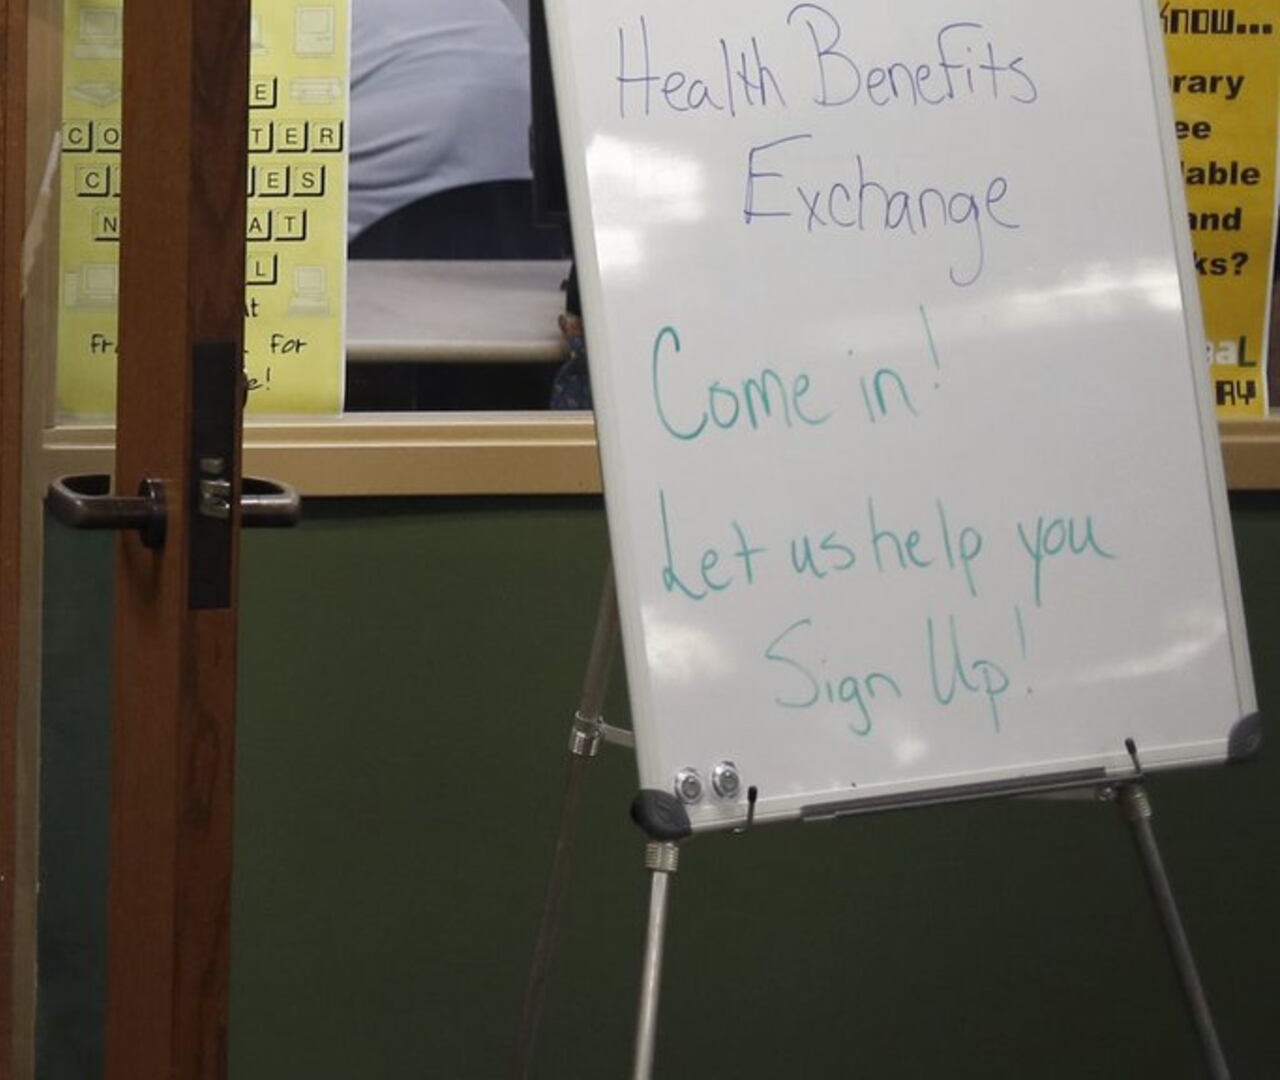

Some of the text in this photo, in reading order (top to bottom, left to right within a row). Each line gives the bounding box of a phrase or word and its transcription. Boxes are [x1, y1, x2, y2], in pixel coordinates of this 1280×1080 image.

[617, 3, 1038, 117] Health Benefits
[1169, 73, 1245, 101] rary
[745, 133, 1020, 287] Exchange
[652, 305, 945, 440] Come in!
[657, 490, 1119, 607] Let us help you
[763, 605, 1035, 737] Sign Up!
